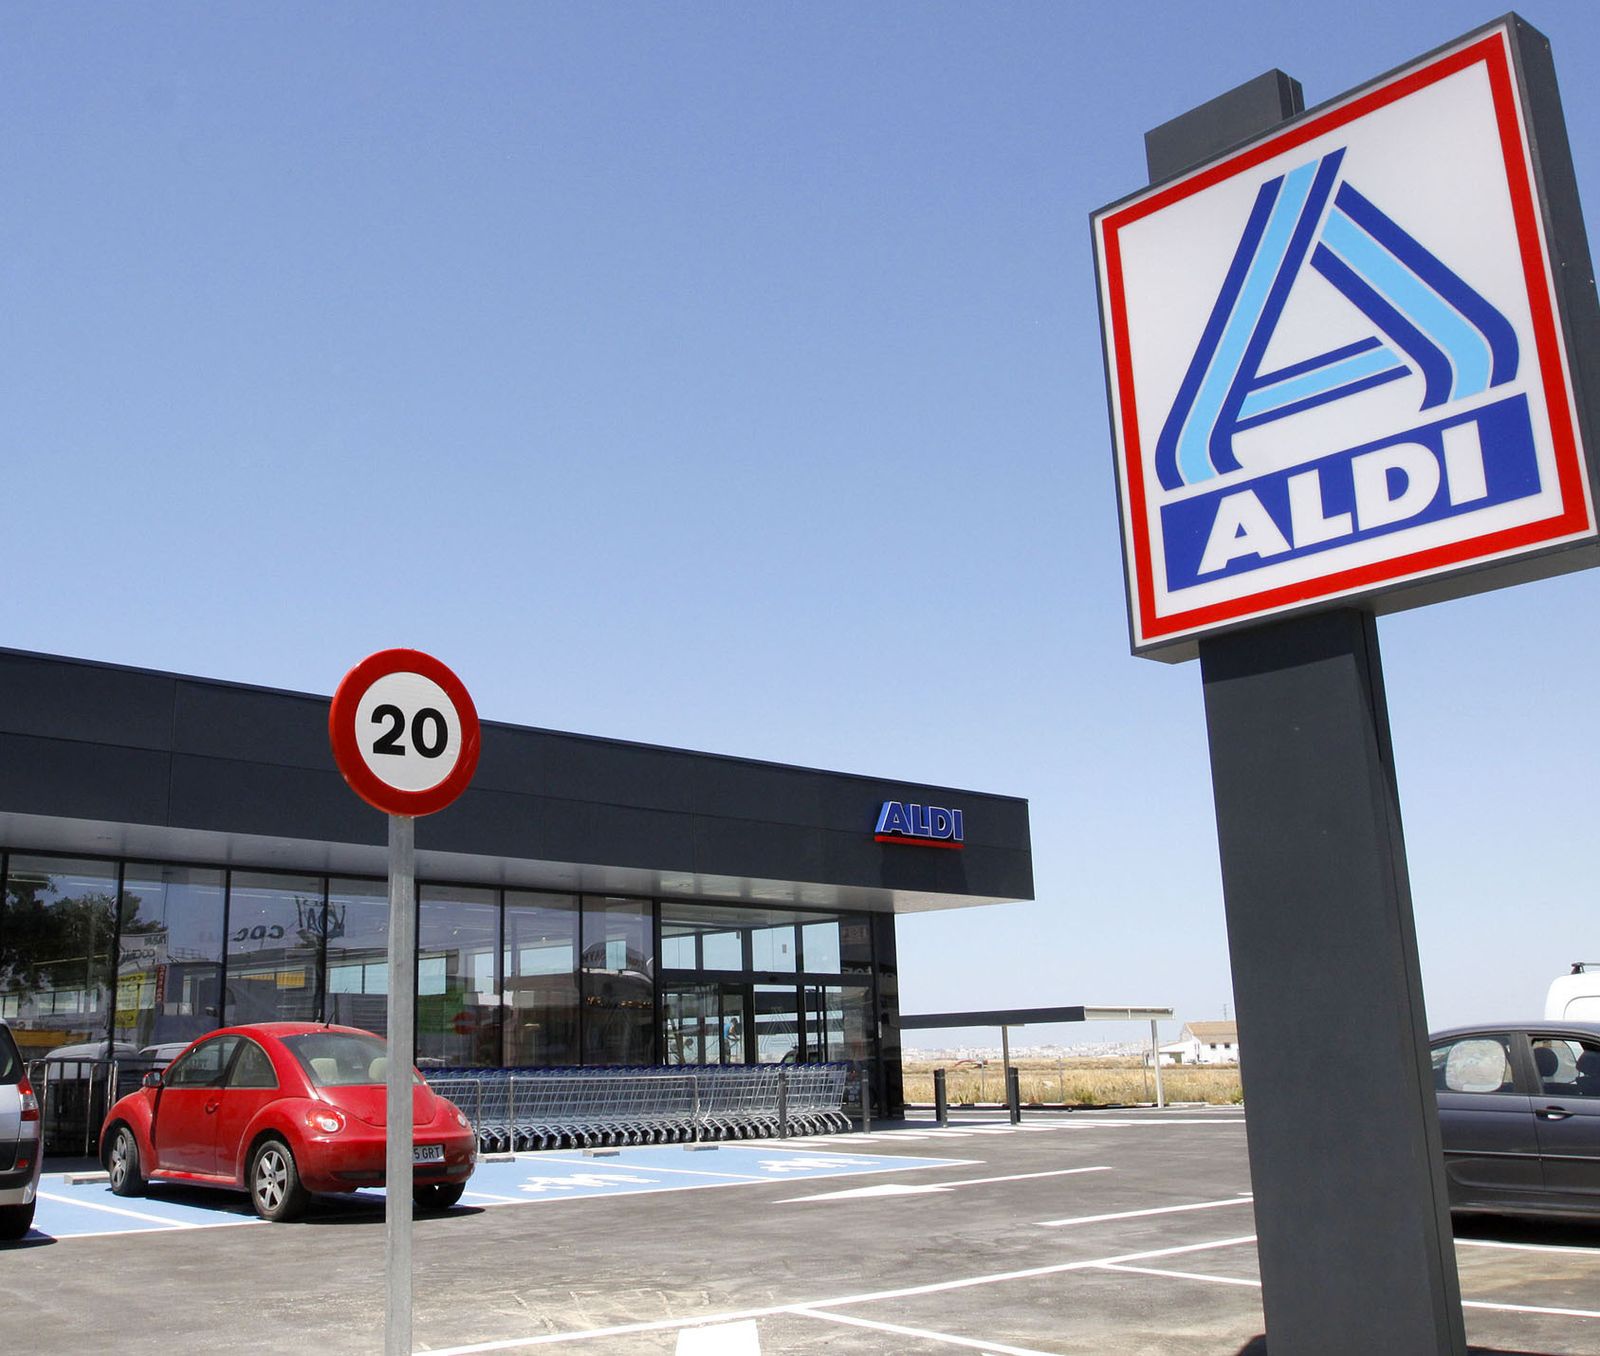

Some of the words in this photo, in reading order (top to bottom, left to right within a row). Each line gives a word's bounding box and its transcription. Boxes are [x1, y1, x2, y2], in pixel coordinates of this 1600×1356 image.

[1197, 420, 1488, 575] ALDI
[371, 703, 448, 758] 20
[874, 800, 964, 841] ALDI
[421, 1147, 441, 1160] GRT
